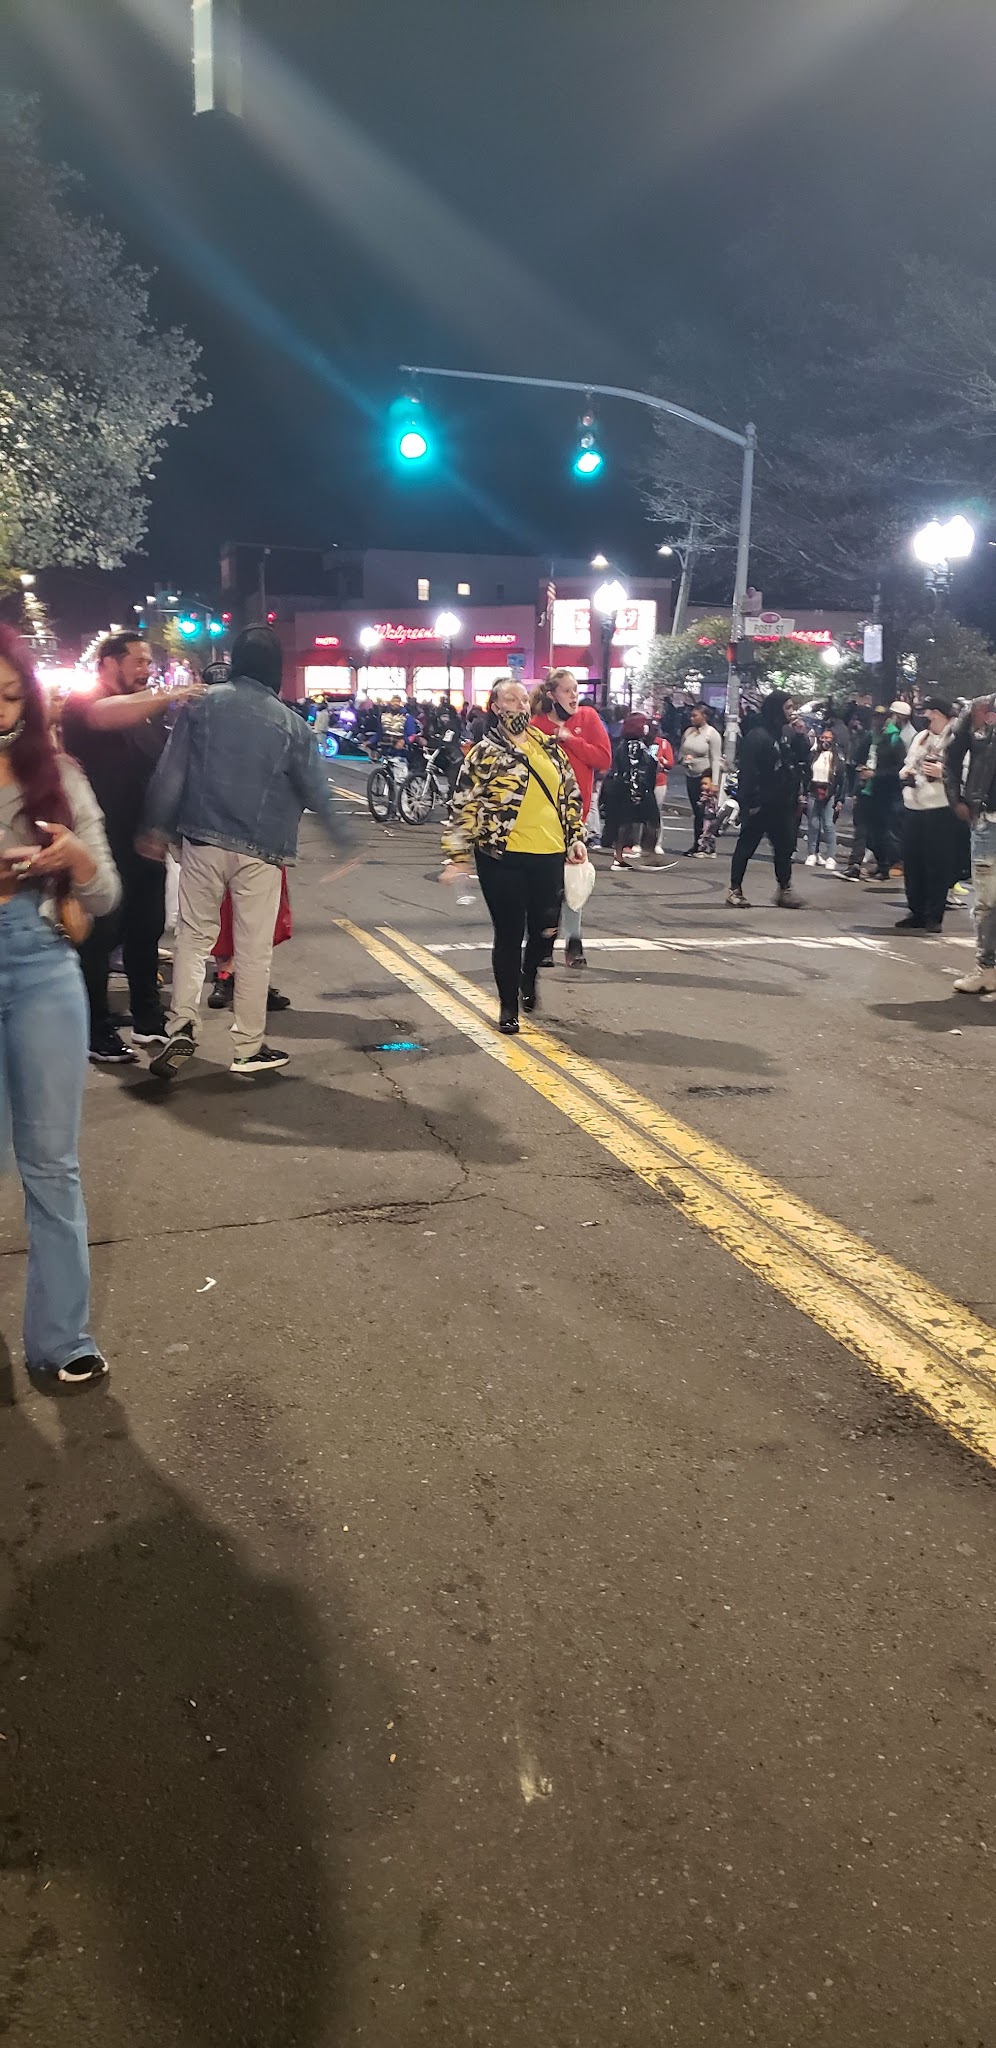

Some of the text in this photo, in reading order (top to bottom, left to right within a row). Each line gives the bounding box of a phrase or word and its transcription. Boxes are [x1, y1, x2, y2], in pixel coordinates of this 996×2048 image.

[754, 624, 784, 635] POST ST
[314, 636, 339, 647] PHOTO
[474, 634, 517, 645] PHARMACY
